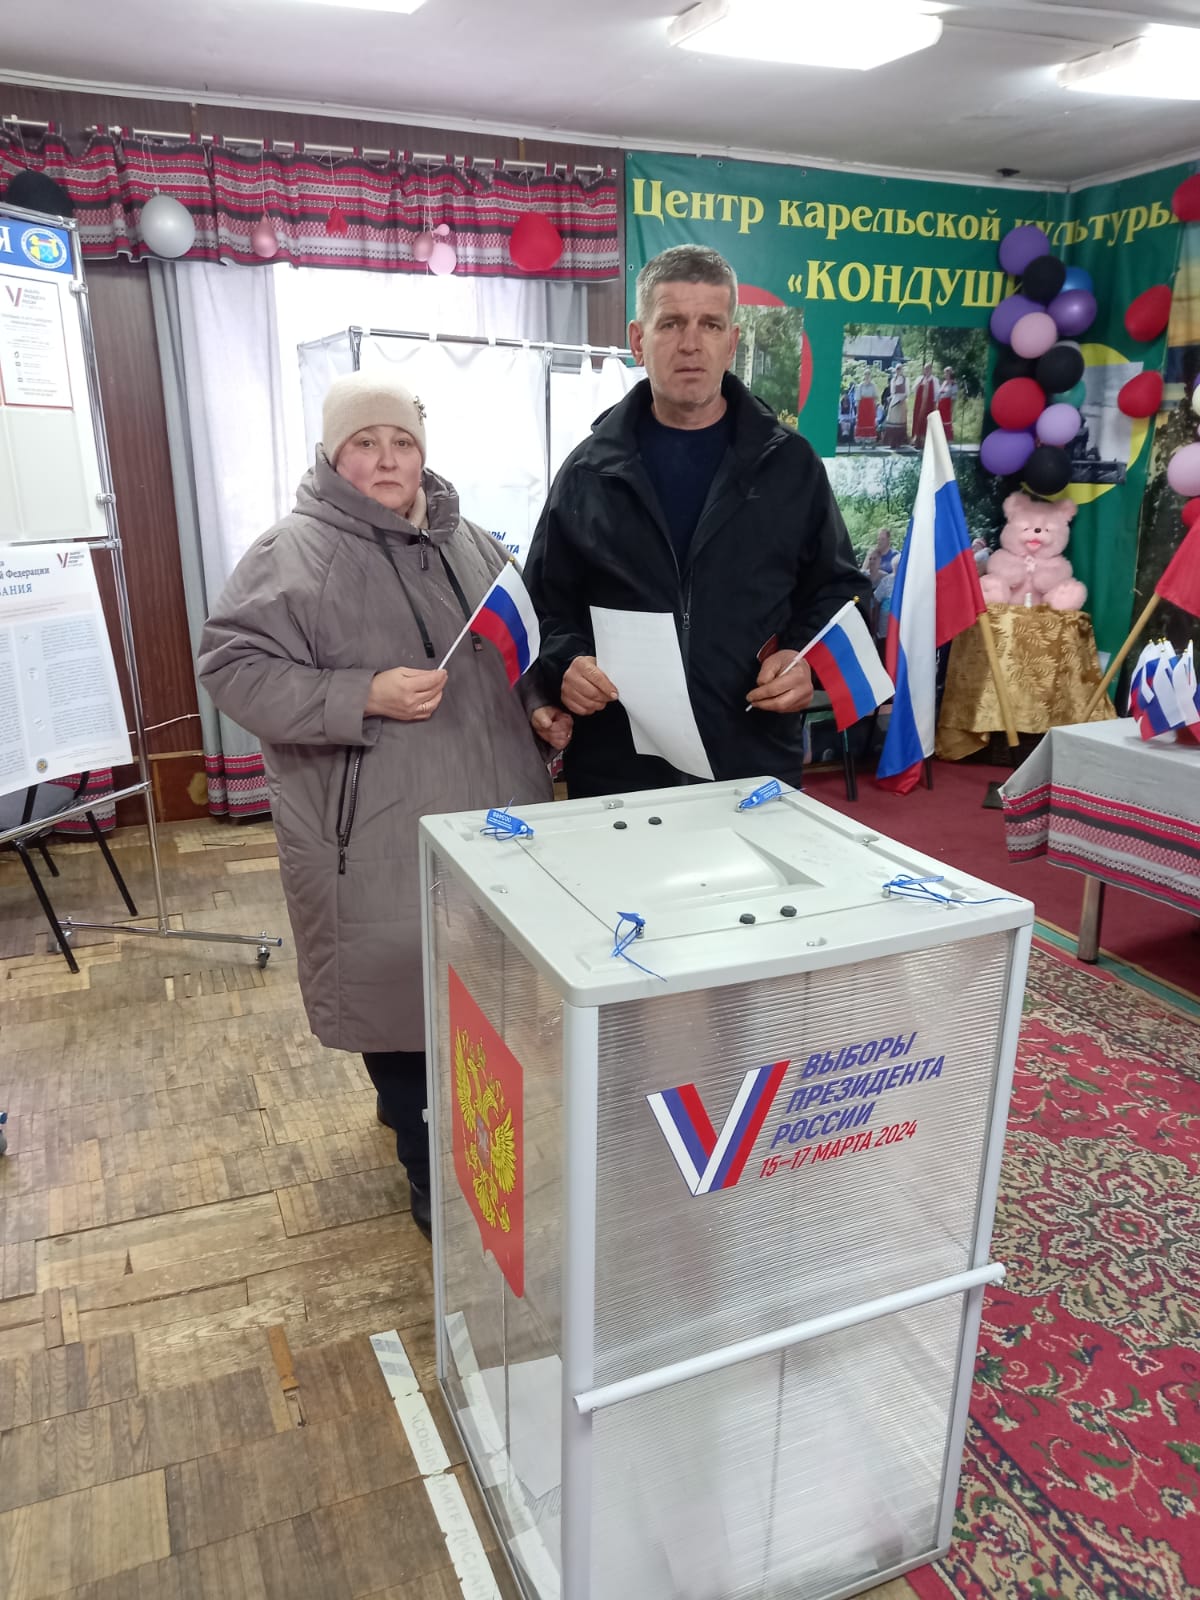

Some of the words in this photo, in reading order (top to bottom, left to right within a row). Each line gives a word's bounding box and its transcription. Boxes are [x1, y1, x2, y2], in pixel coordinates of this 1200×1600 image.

[632, 178, 764, 234] Центр
[779, 199, 1001, 241] карельской
[0, 583, 32, 596] АНИЯ
[6, 567, 50, 579] Федерации
[801, 1032, 918, 1079] ВЫБОРЫ
[786, 1055, 946, 1114] ПРЕЗИДЕНТА
[770, 1101, 876, 1149] РОССИИ
[811, 1131, 873, 1164] МАРТА
[874, 1119, 917, 1147] 2024
